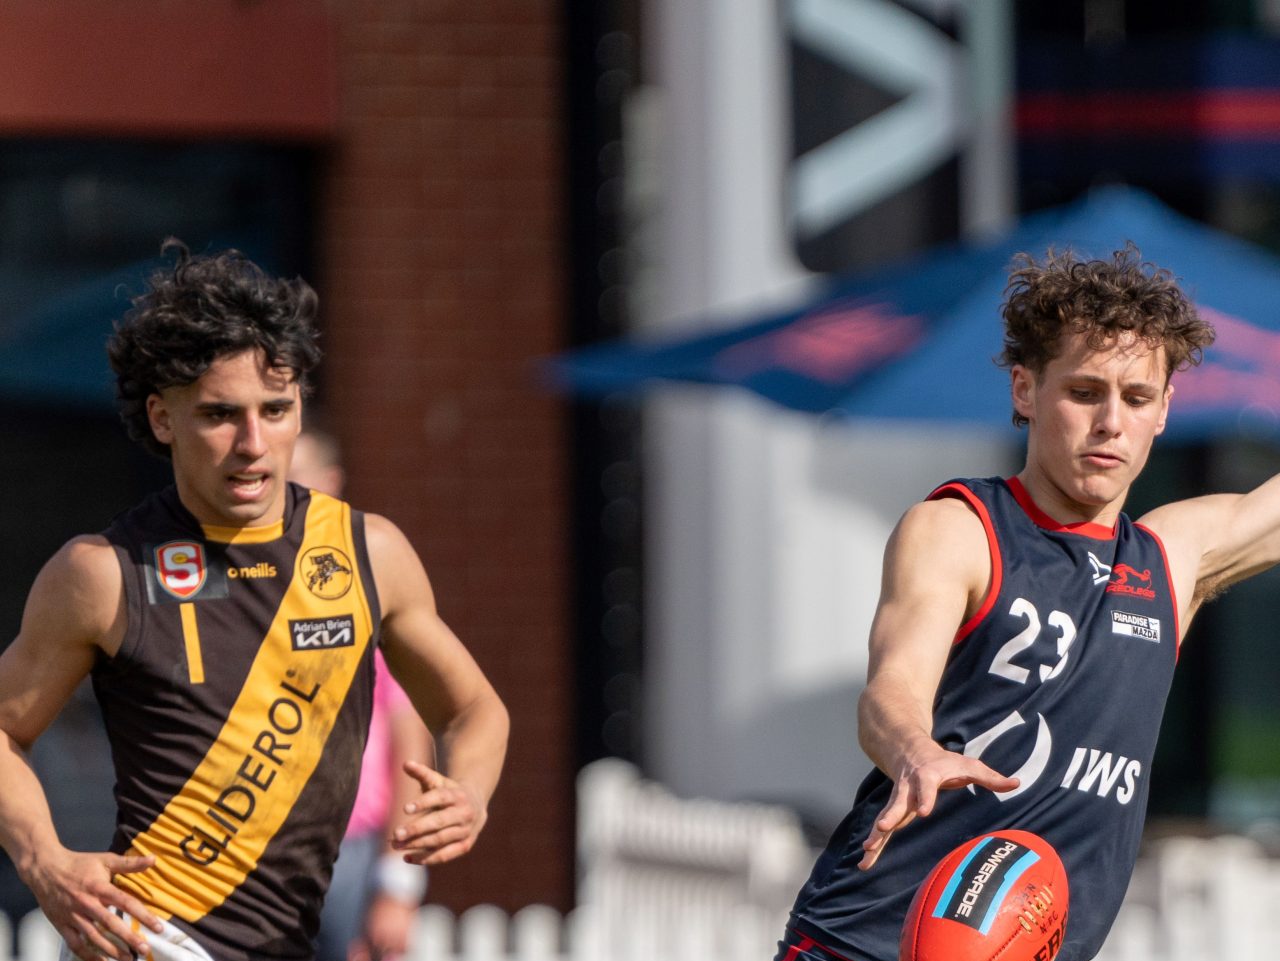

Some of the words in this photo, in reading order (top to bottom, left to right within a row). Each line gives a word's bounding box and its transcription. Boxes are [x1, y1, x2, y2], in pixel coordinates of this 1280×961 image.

[293, 621, 326, 634] Adrian
[326, 619, 352, 631] Brien
[1113, 612, 1149, 628] PARADISE
[1132, 626, 1158, 640] MAZDA
[987, 597, 1077, 684] 23
[178, 680, 321, 866] GLIDEROL
[1059, 747, 1141, 805] IWS
